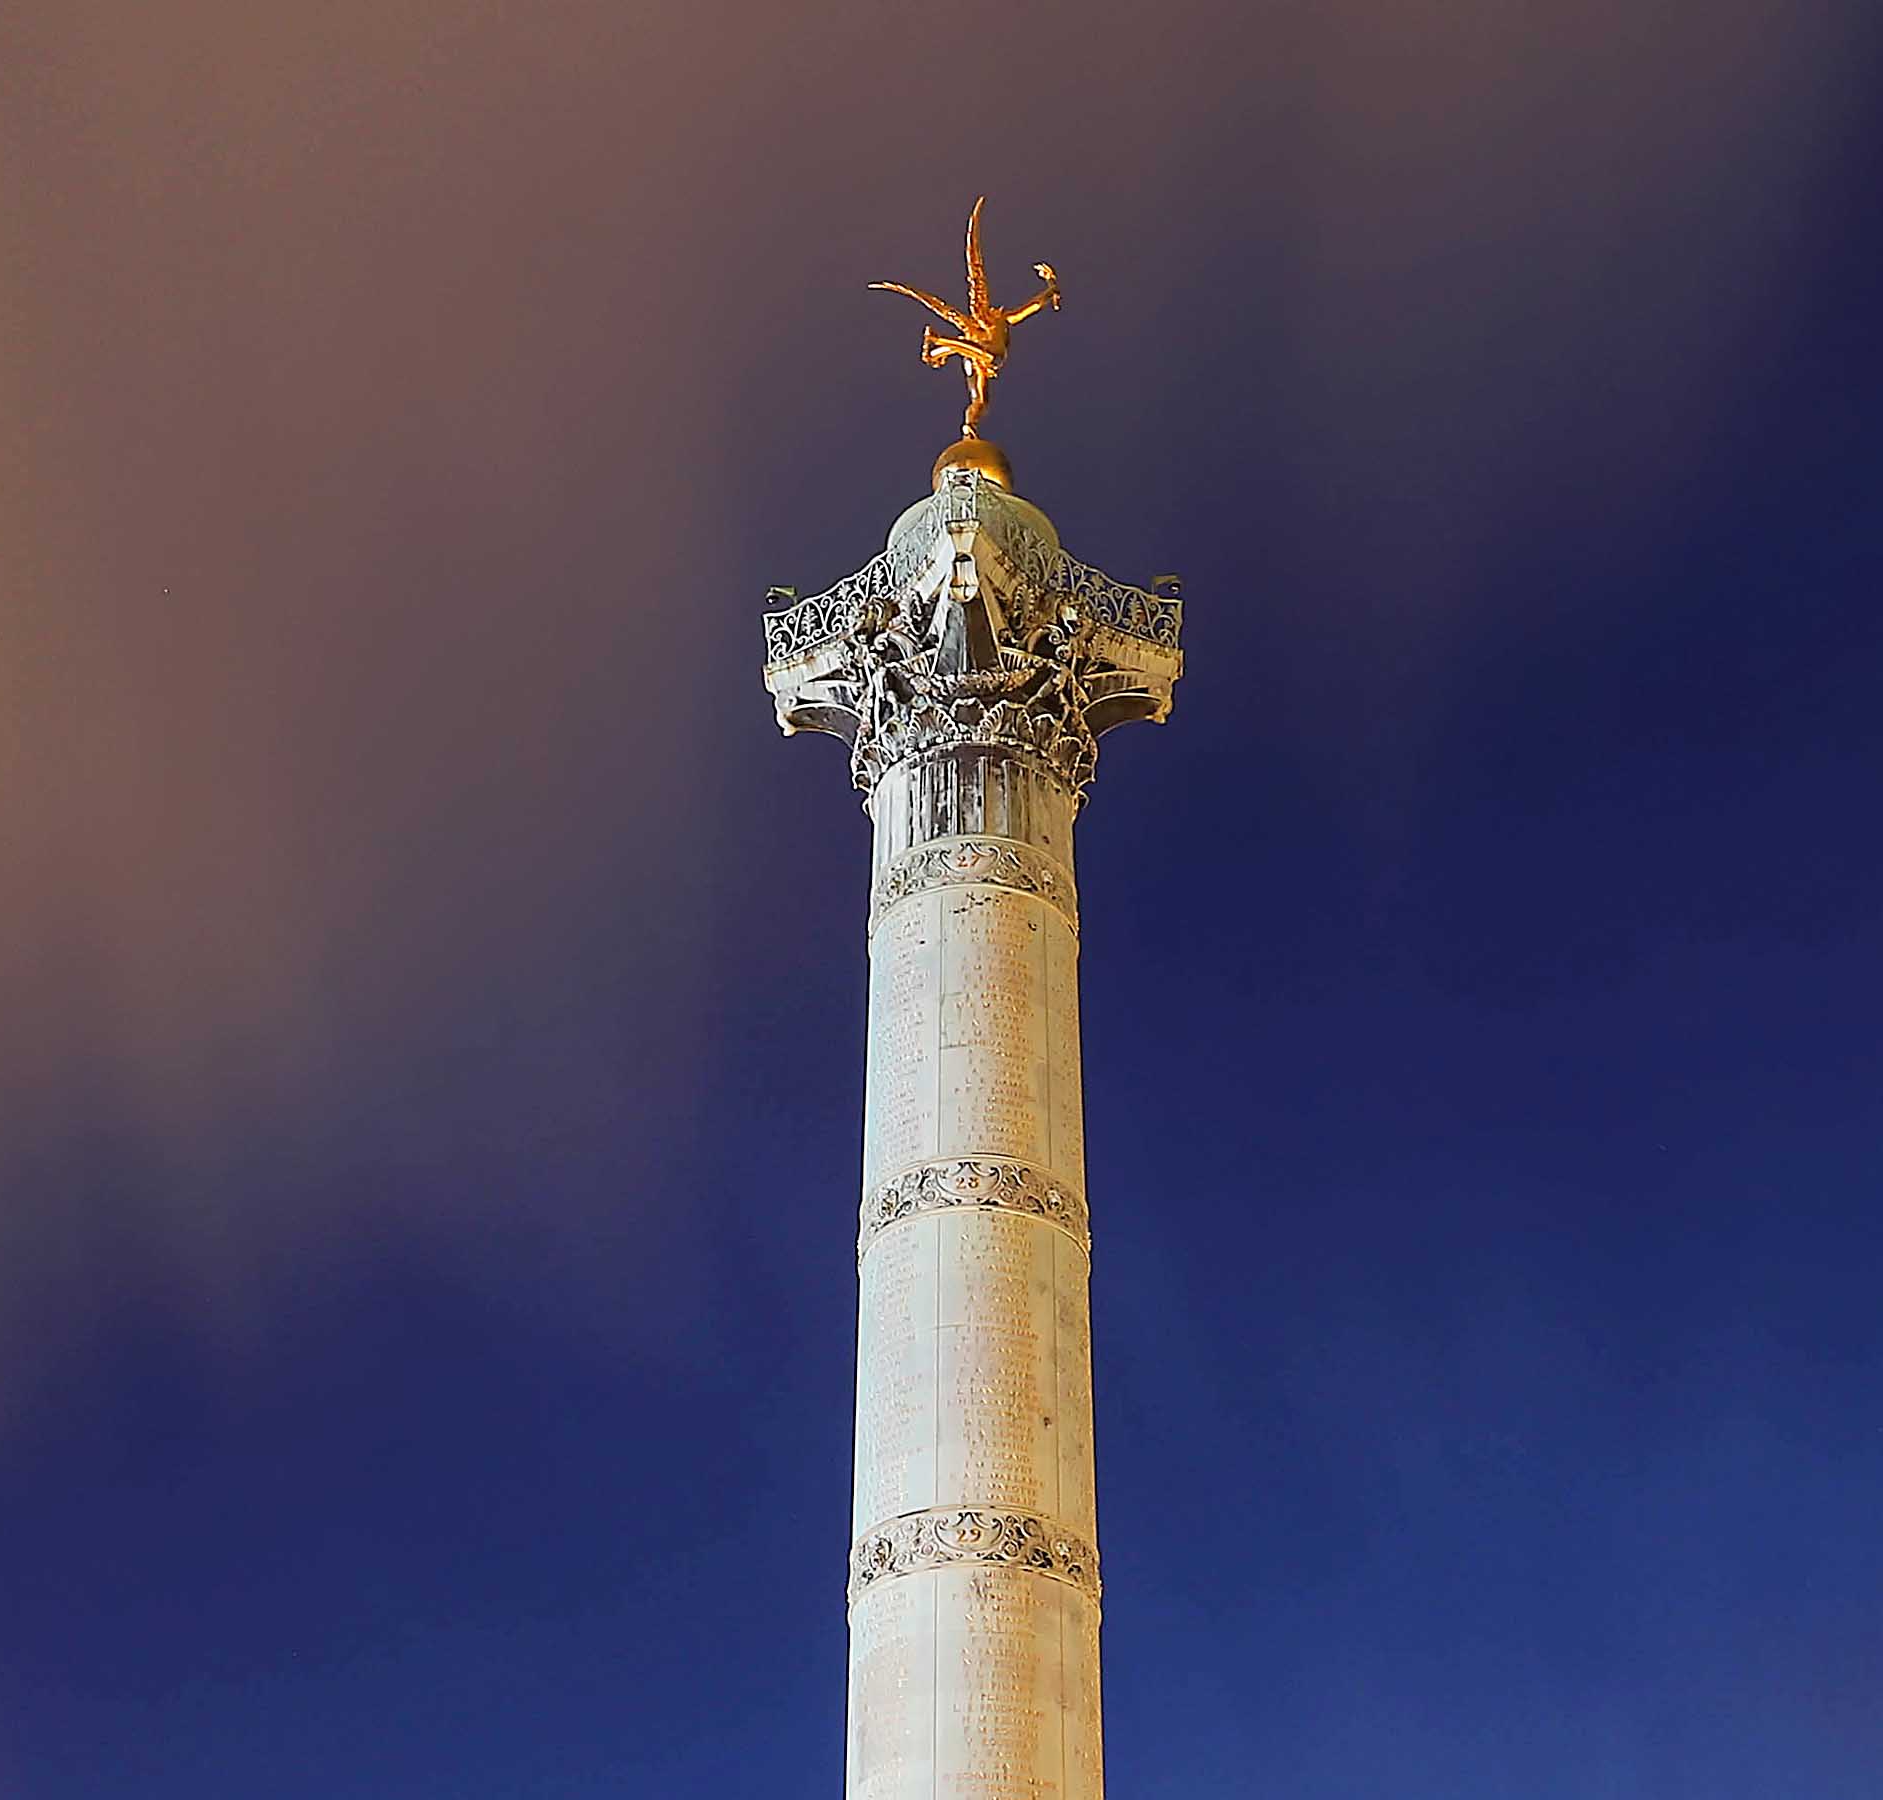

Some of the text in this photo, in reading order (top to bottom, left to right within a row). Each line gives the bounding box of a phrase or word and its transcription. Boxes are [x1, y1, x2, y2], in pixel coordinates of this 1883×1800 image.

[957, 855, 979, 867] 27
[956, 1177, 979, 1189] 28
[957, 1529, 981, 1542] 29
